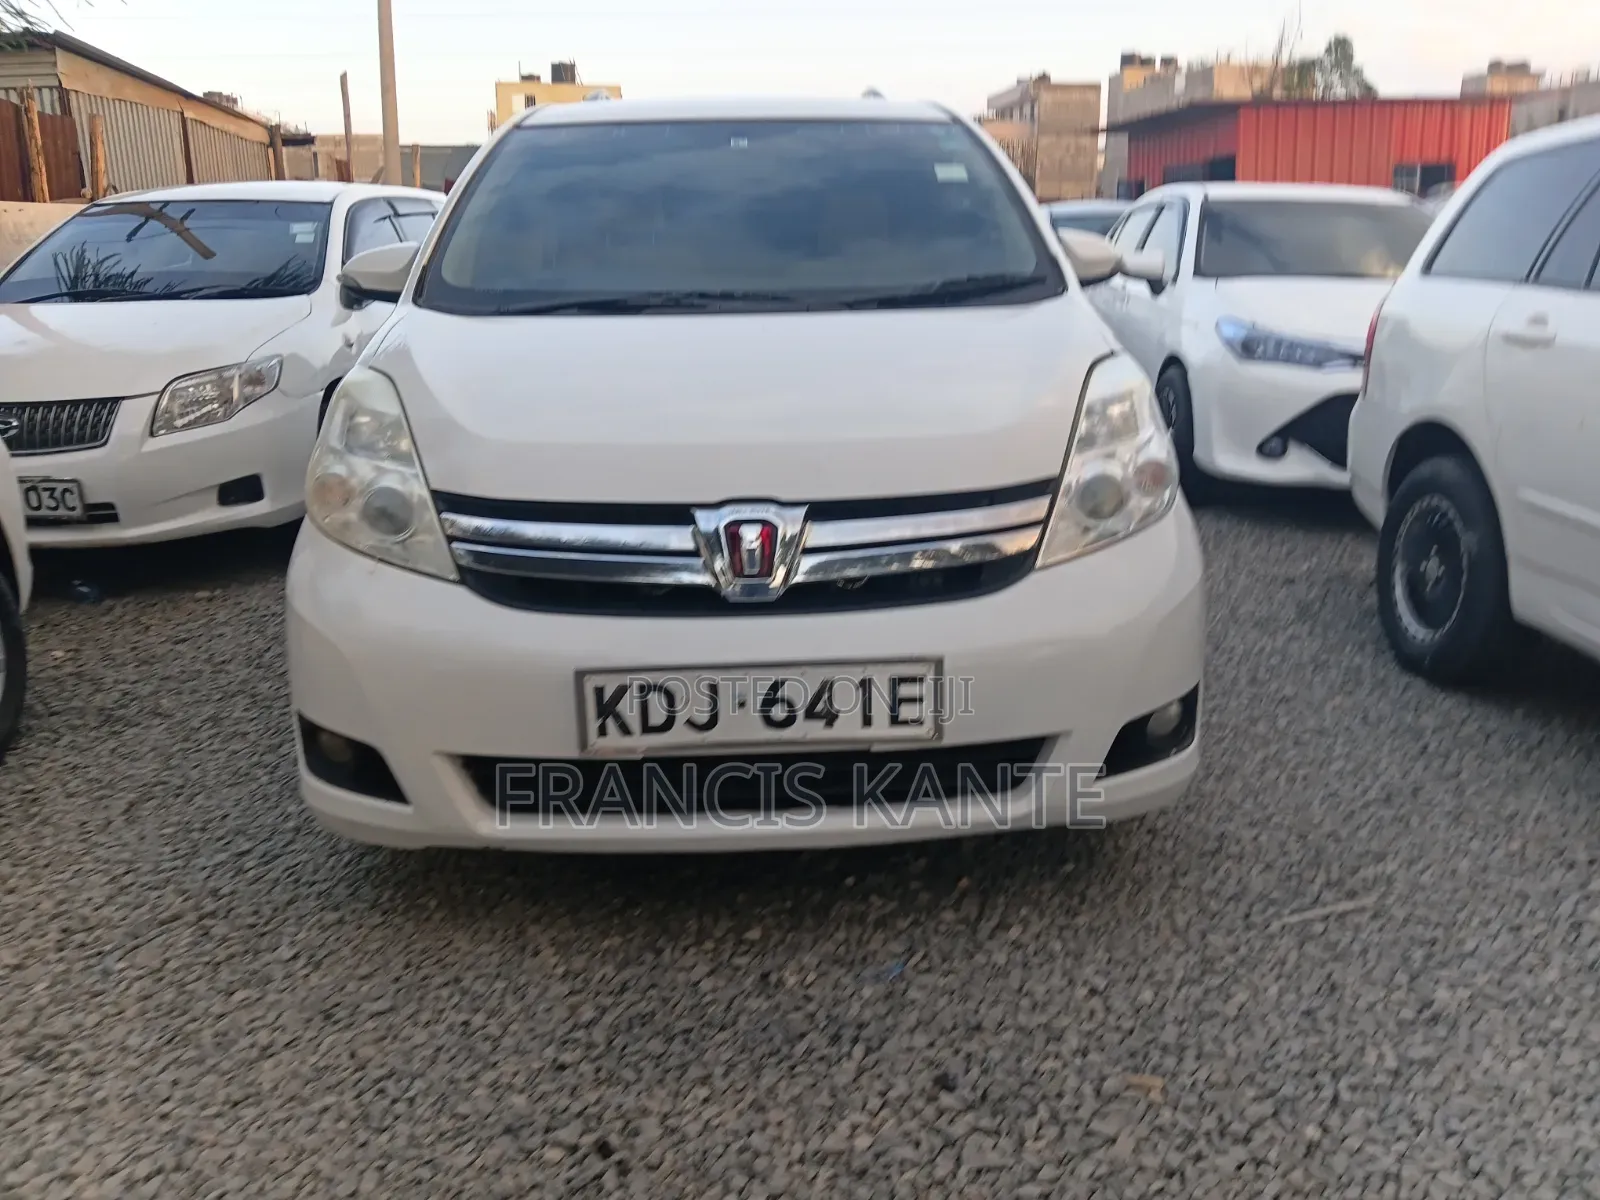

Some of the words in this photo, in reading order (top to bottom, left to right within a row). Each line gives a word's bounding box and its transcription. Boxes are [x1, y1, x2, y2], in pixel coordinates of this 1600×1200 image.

[24, 485, 77, 512] 03C
[594, 682, 720, 737] KDJ
[760, 673, 925, 729] 641E
